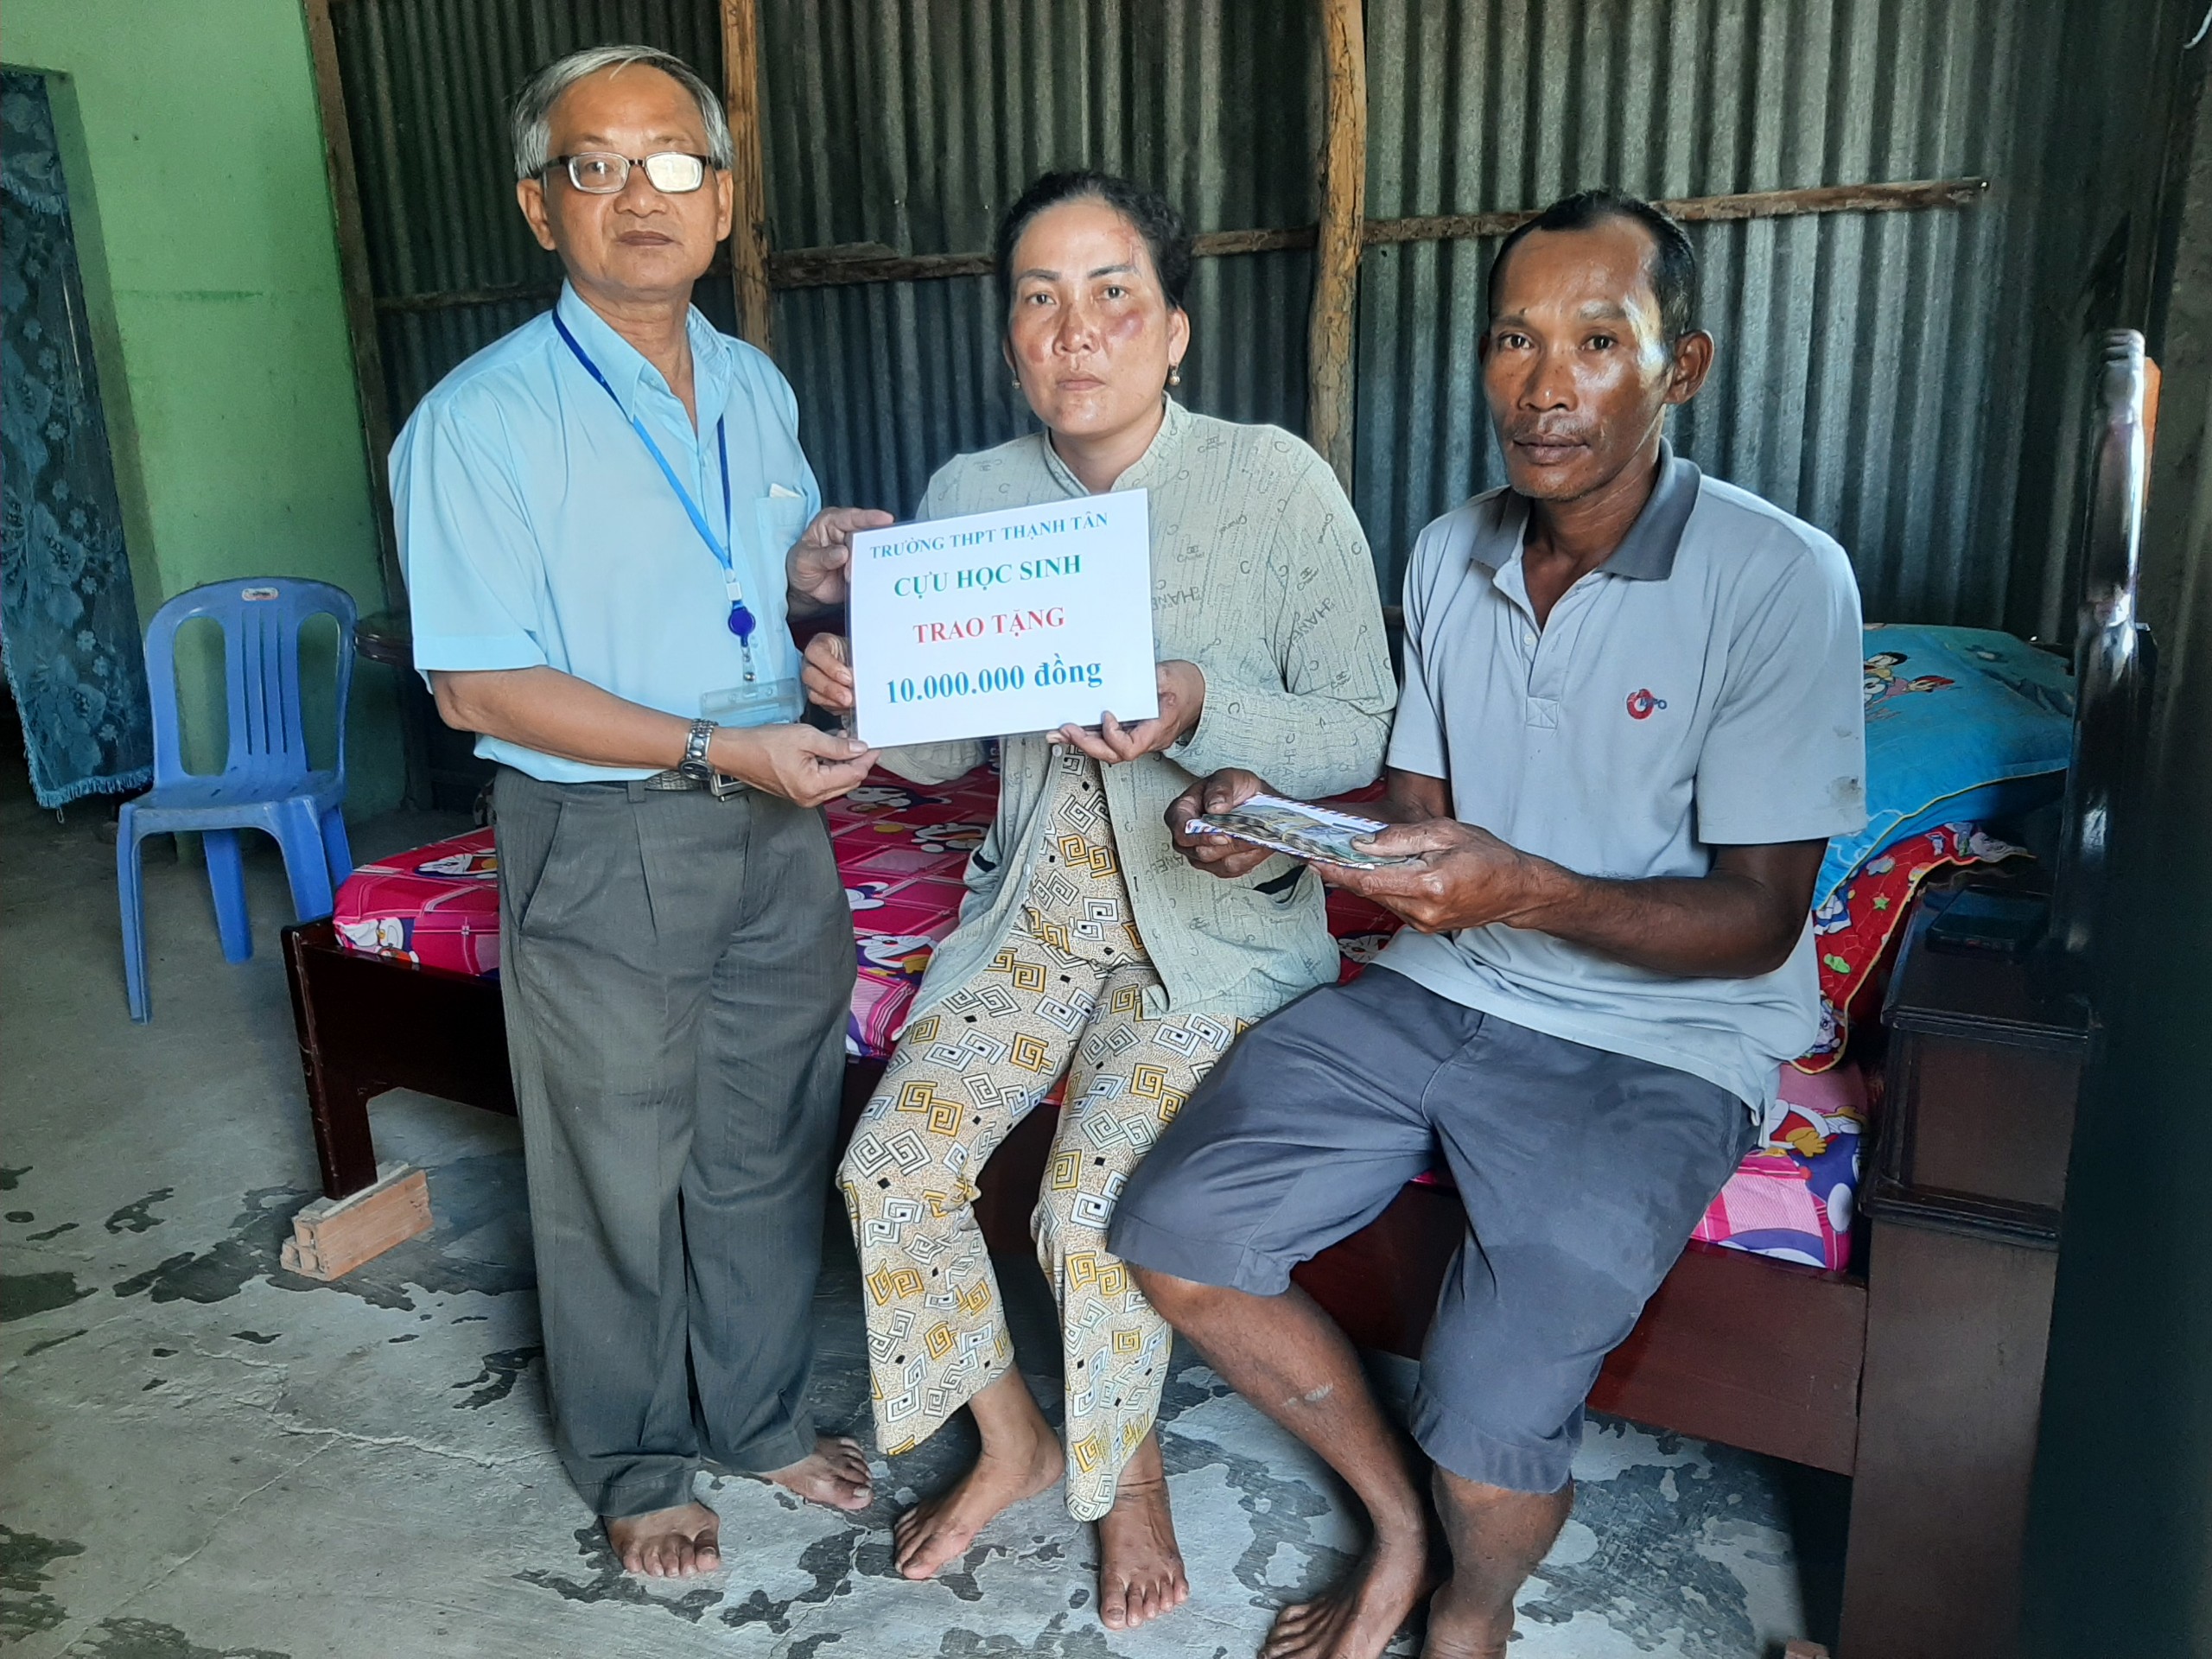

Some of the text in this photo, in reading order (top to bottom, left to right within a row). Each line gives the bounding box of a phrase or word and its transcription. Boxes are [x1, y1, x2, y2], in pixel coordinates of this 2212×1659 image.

[870, 511, 1108, 559] TRƯỜNG THPT THẠNH TÂN
[893, 554, 1081, 600] CỰU HỌC SINH
[912, 607, 1065, 645] TRAO TẶNG
[887, 652, 1103, 704] 10.000.000 đồng
